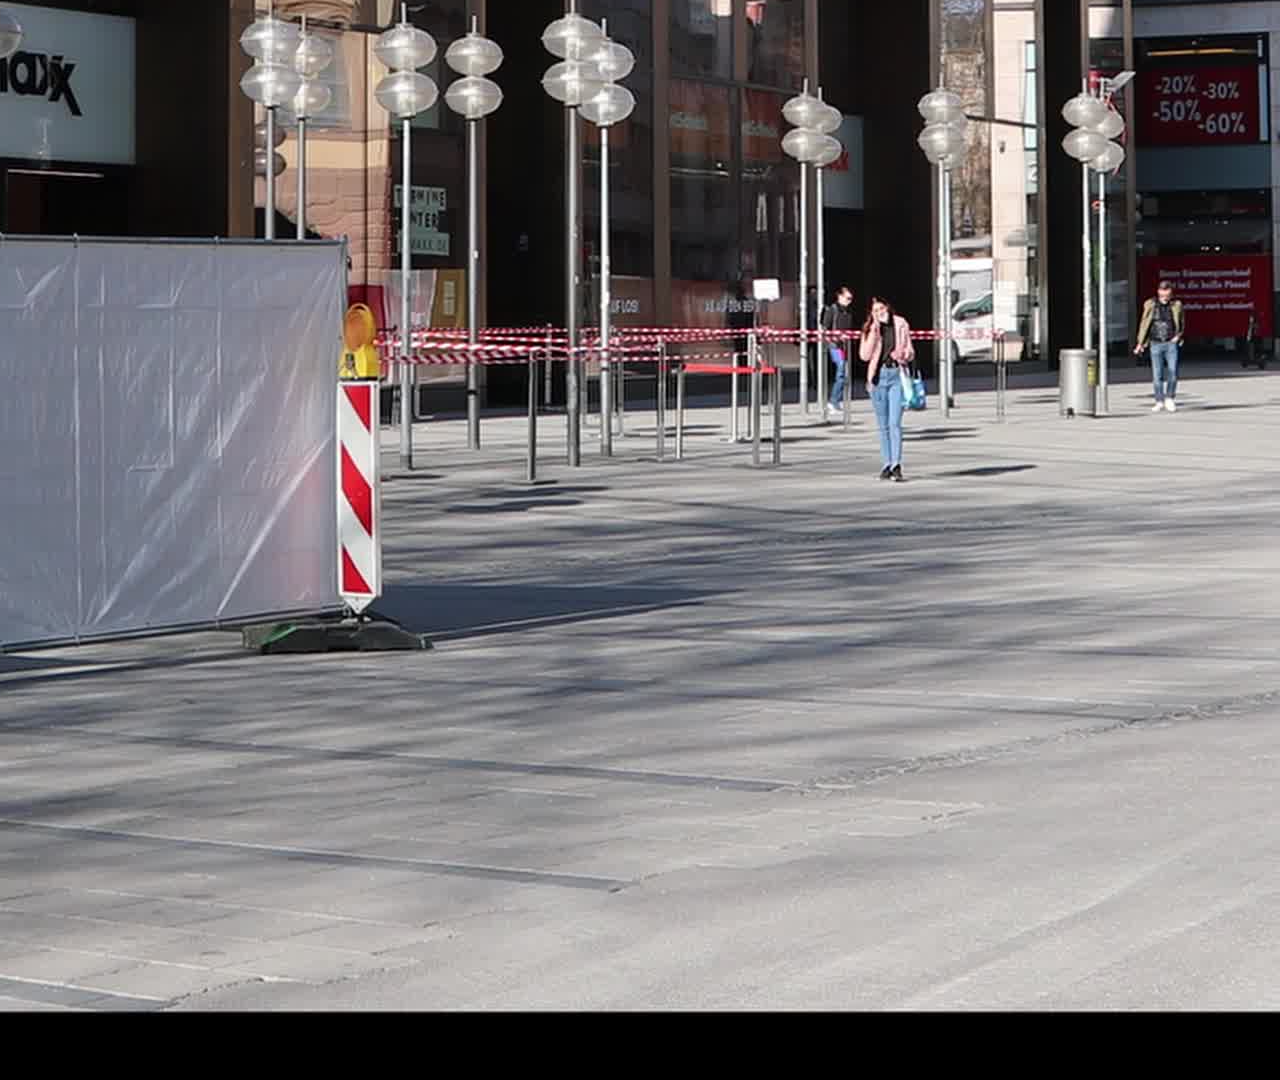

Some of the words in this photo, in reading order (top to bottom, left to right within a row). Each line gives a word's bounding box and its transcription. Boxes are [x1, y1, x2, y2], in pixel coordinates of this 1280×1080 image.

[1154, 75, 1196, 94] -20%
[1202, 81, 1239, 99] -30%
[1152, 99, 1200, 121] -50%
[1198, 112, 1245, 133] -60%
